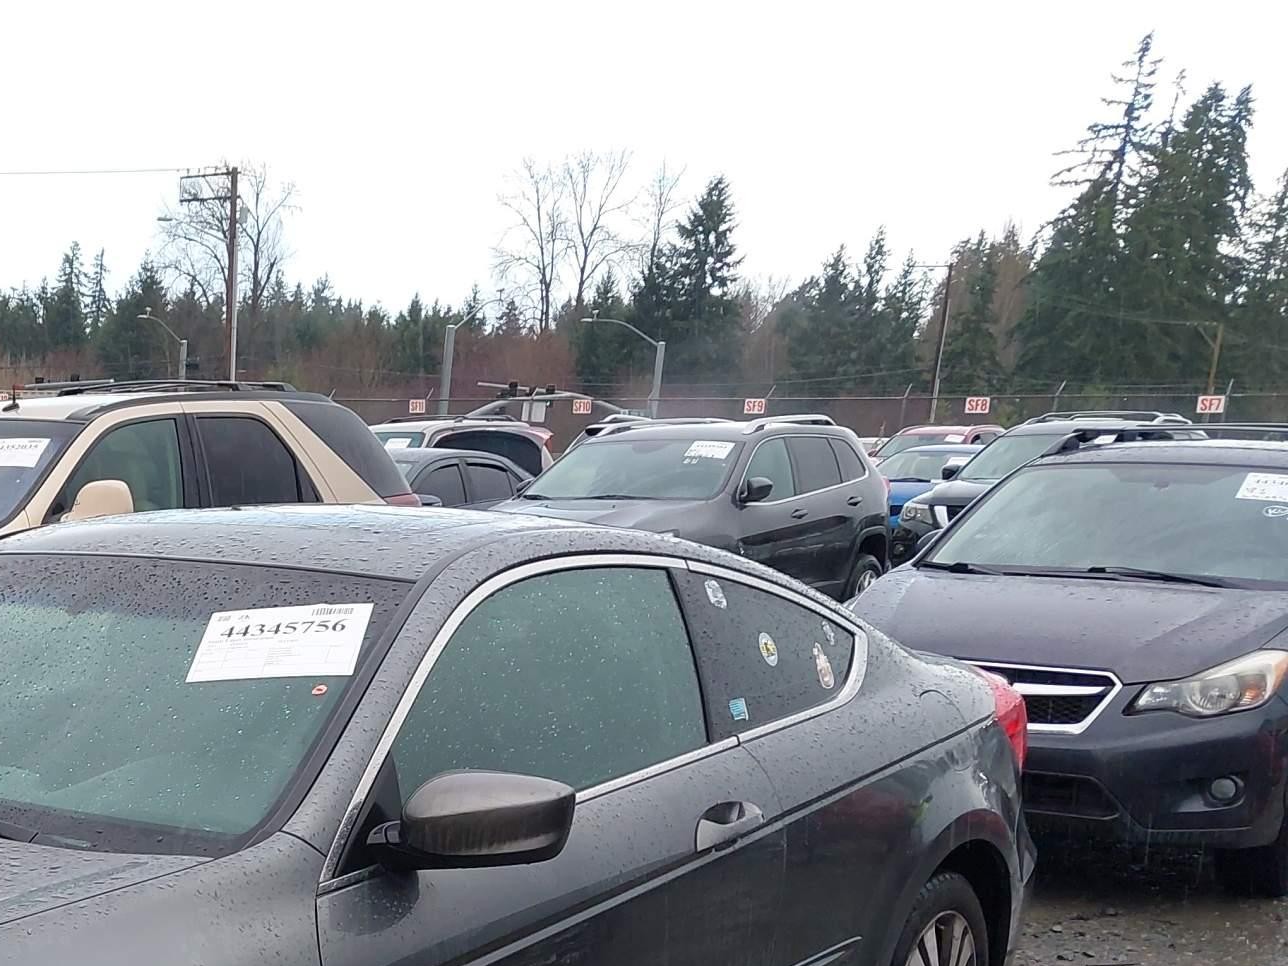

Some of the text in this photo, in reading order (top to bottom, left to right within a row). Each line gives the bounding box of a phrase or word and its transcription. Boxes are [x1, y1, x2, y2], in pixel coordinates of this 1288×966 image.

[410, 400, 424, 412] SF11
[574, 400, 590, 412] SF10
[746, 400, 763, 412] SF9
[967, 398, 988, 412] SF8
[1200, 398, 1223, 412] SF7
[220, 619, 347, 638] 44345756
